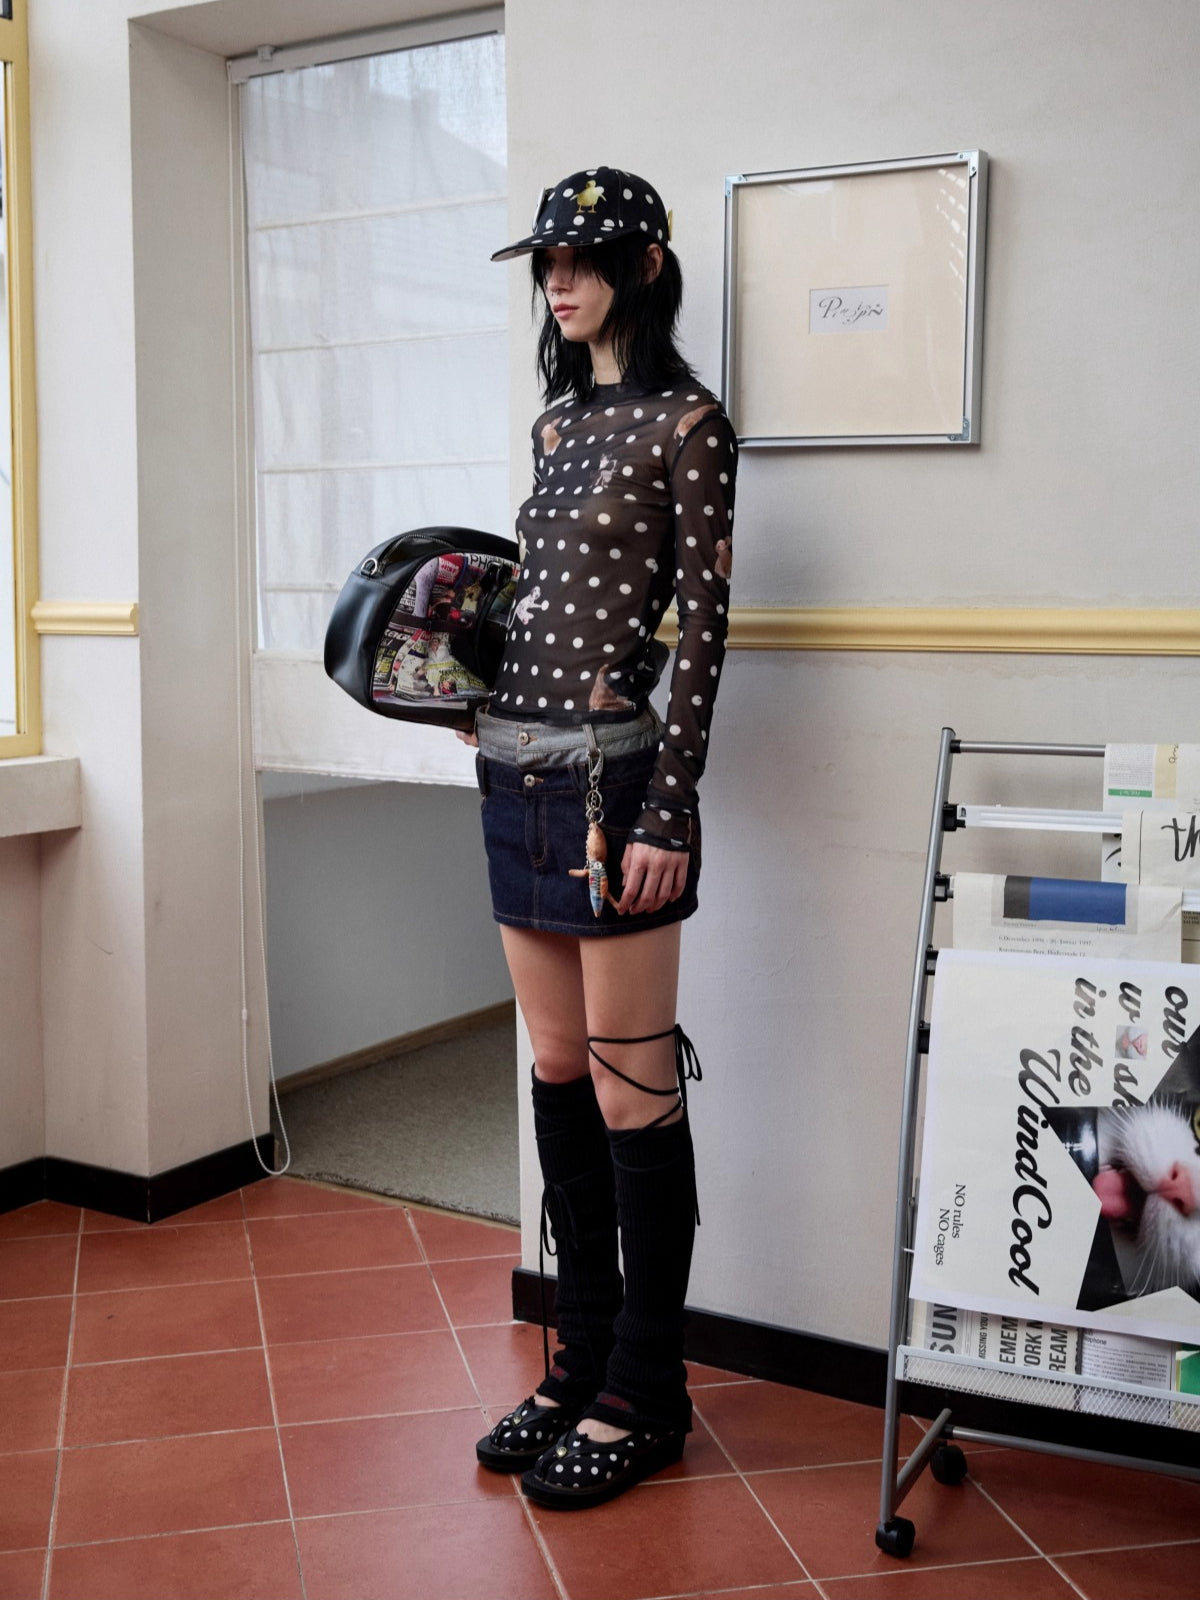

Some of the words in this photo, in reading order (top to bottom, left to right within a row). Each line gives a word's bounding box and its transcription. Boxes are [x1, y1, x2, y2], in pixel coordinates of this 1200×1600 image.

[1073, 977, 1107, 1019] in
[1068, 1026, 1103, 1097] the
[954, 1183, 966, 1207] NO
[938, 1208, 950, 1232] NO
[952, 1209, 964, 1239] rules
[933, 1233, 946, 1266] cages
[1023, 1332, 1043, 1367] ORK
